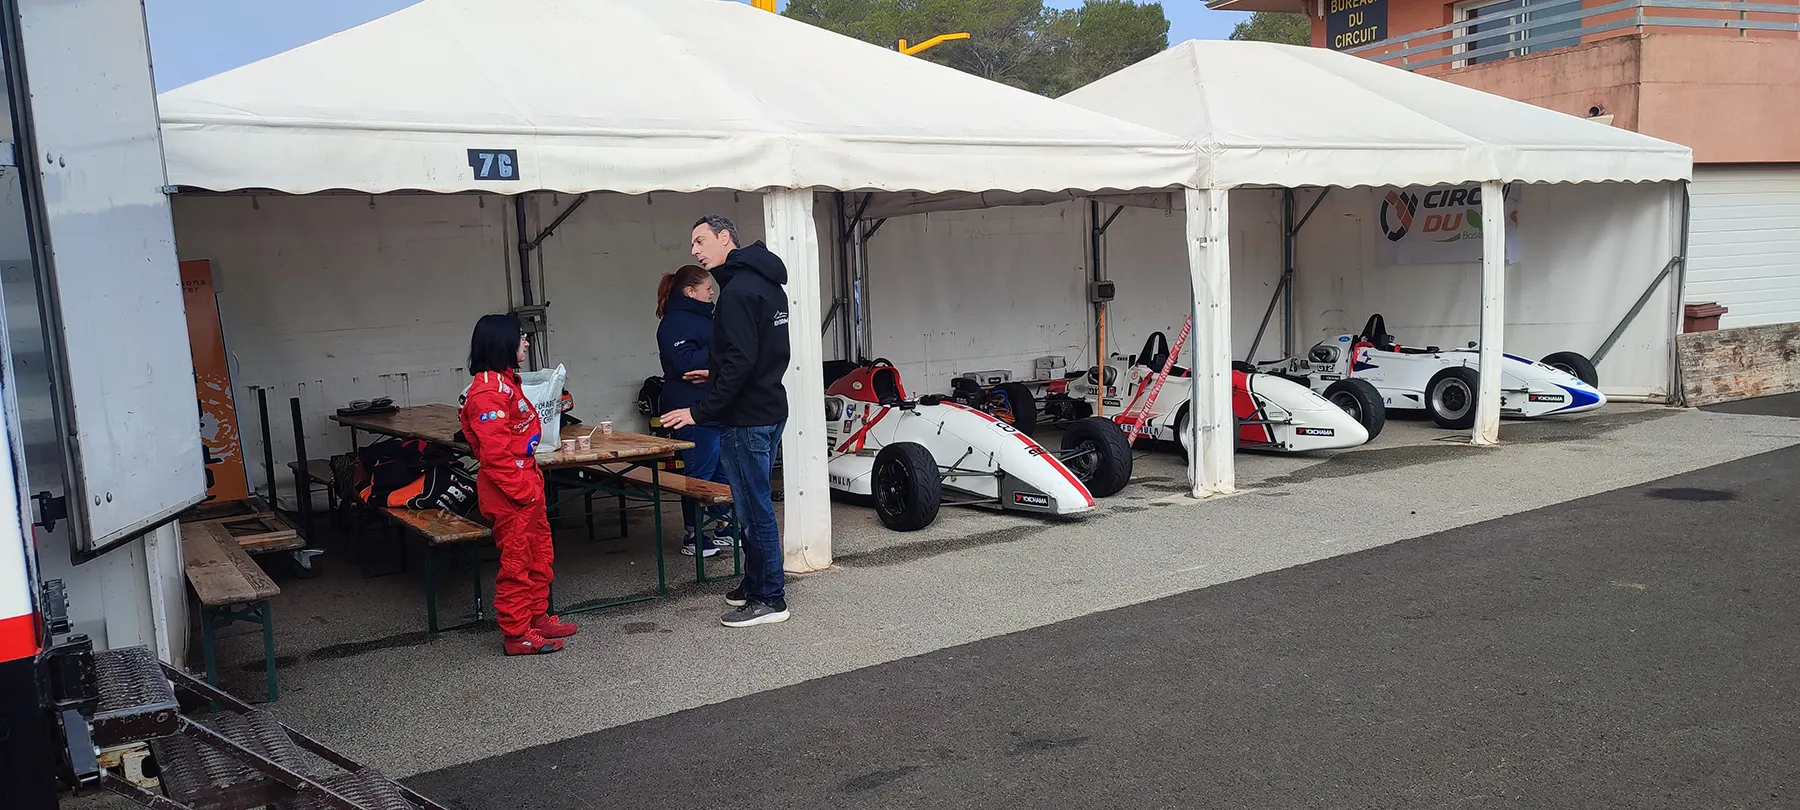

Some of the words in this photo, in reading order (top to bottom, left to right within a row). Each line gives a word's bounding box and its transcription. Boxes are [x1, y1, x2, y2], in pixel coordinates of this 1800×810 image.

[1331, 0, 1376, 13] BURE
[1349, 11, 1364, 28] DU
[1335, 26, 1378, 48] CIRCUIT
[479, 153, 513, 178] 76
[1422, 212, 1463, 233] DU
[1305, 428, 1333, 436] YOKOHAMA
